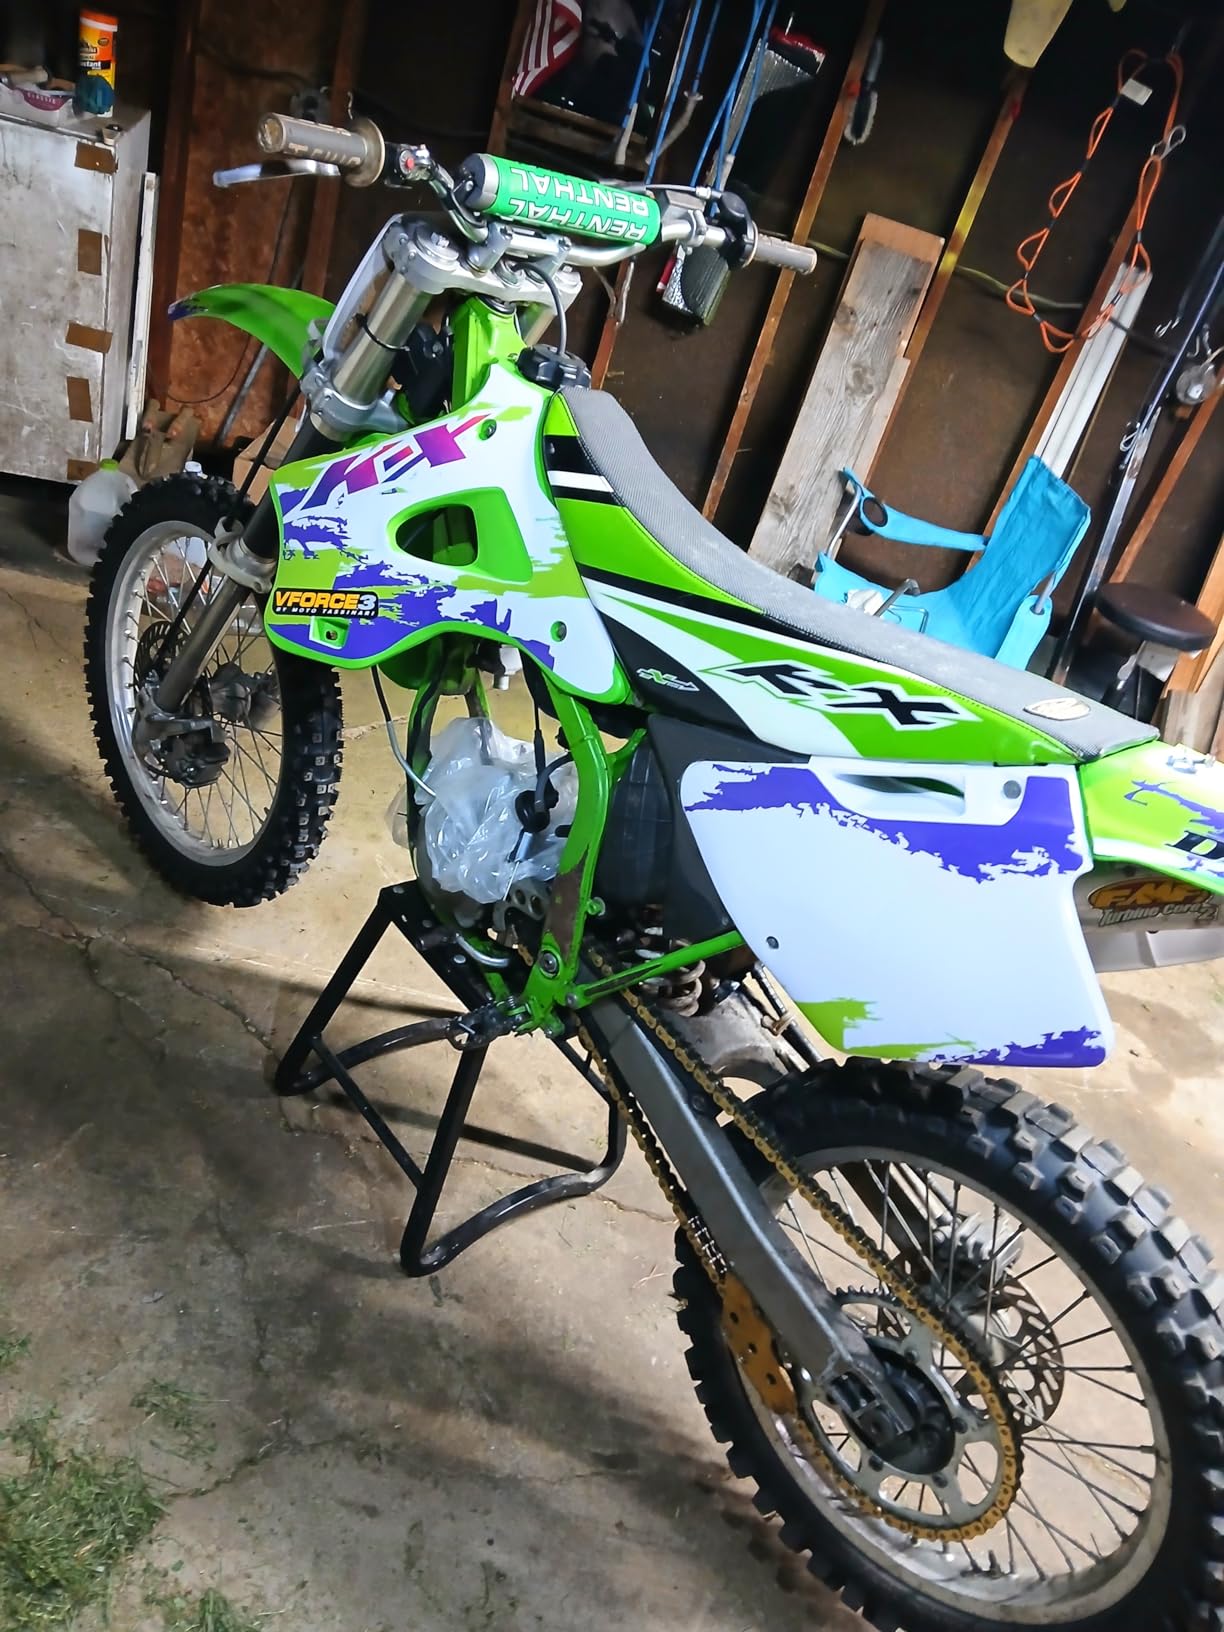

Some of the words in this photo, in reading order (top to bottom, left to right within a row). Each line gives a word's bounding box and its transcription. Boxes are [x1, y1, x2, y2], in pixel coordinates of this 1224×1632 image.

[510, 167, 650, 217] RENTHAL
[509, 197, 649, 241] RENTHAL
[275, 591, 377, 610] VFORCE3
[322, 608, 376, 616] TASSINARI
[1094, 880, 1213, 908] FMF
[1098, 905, 1161, 928] Turbine
